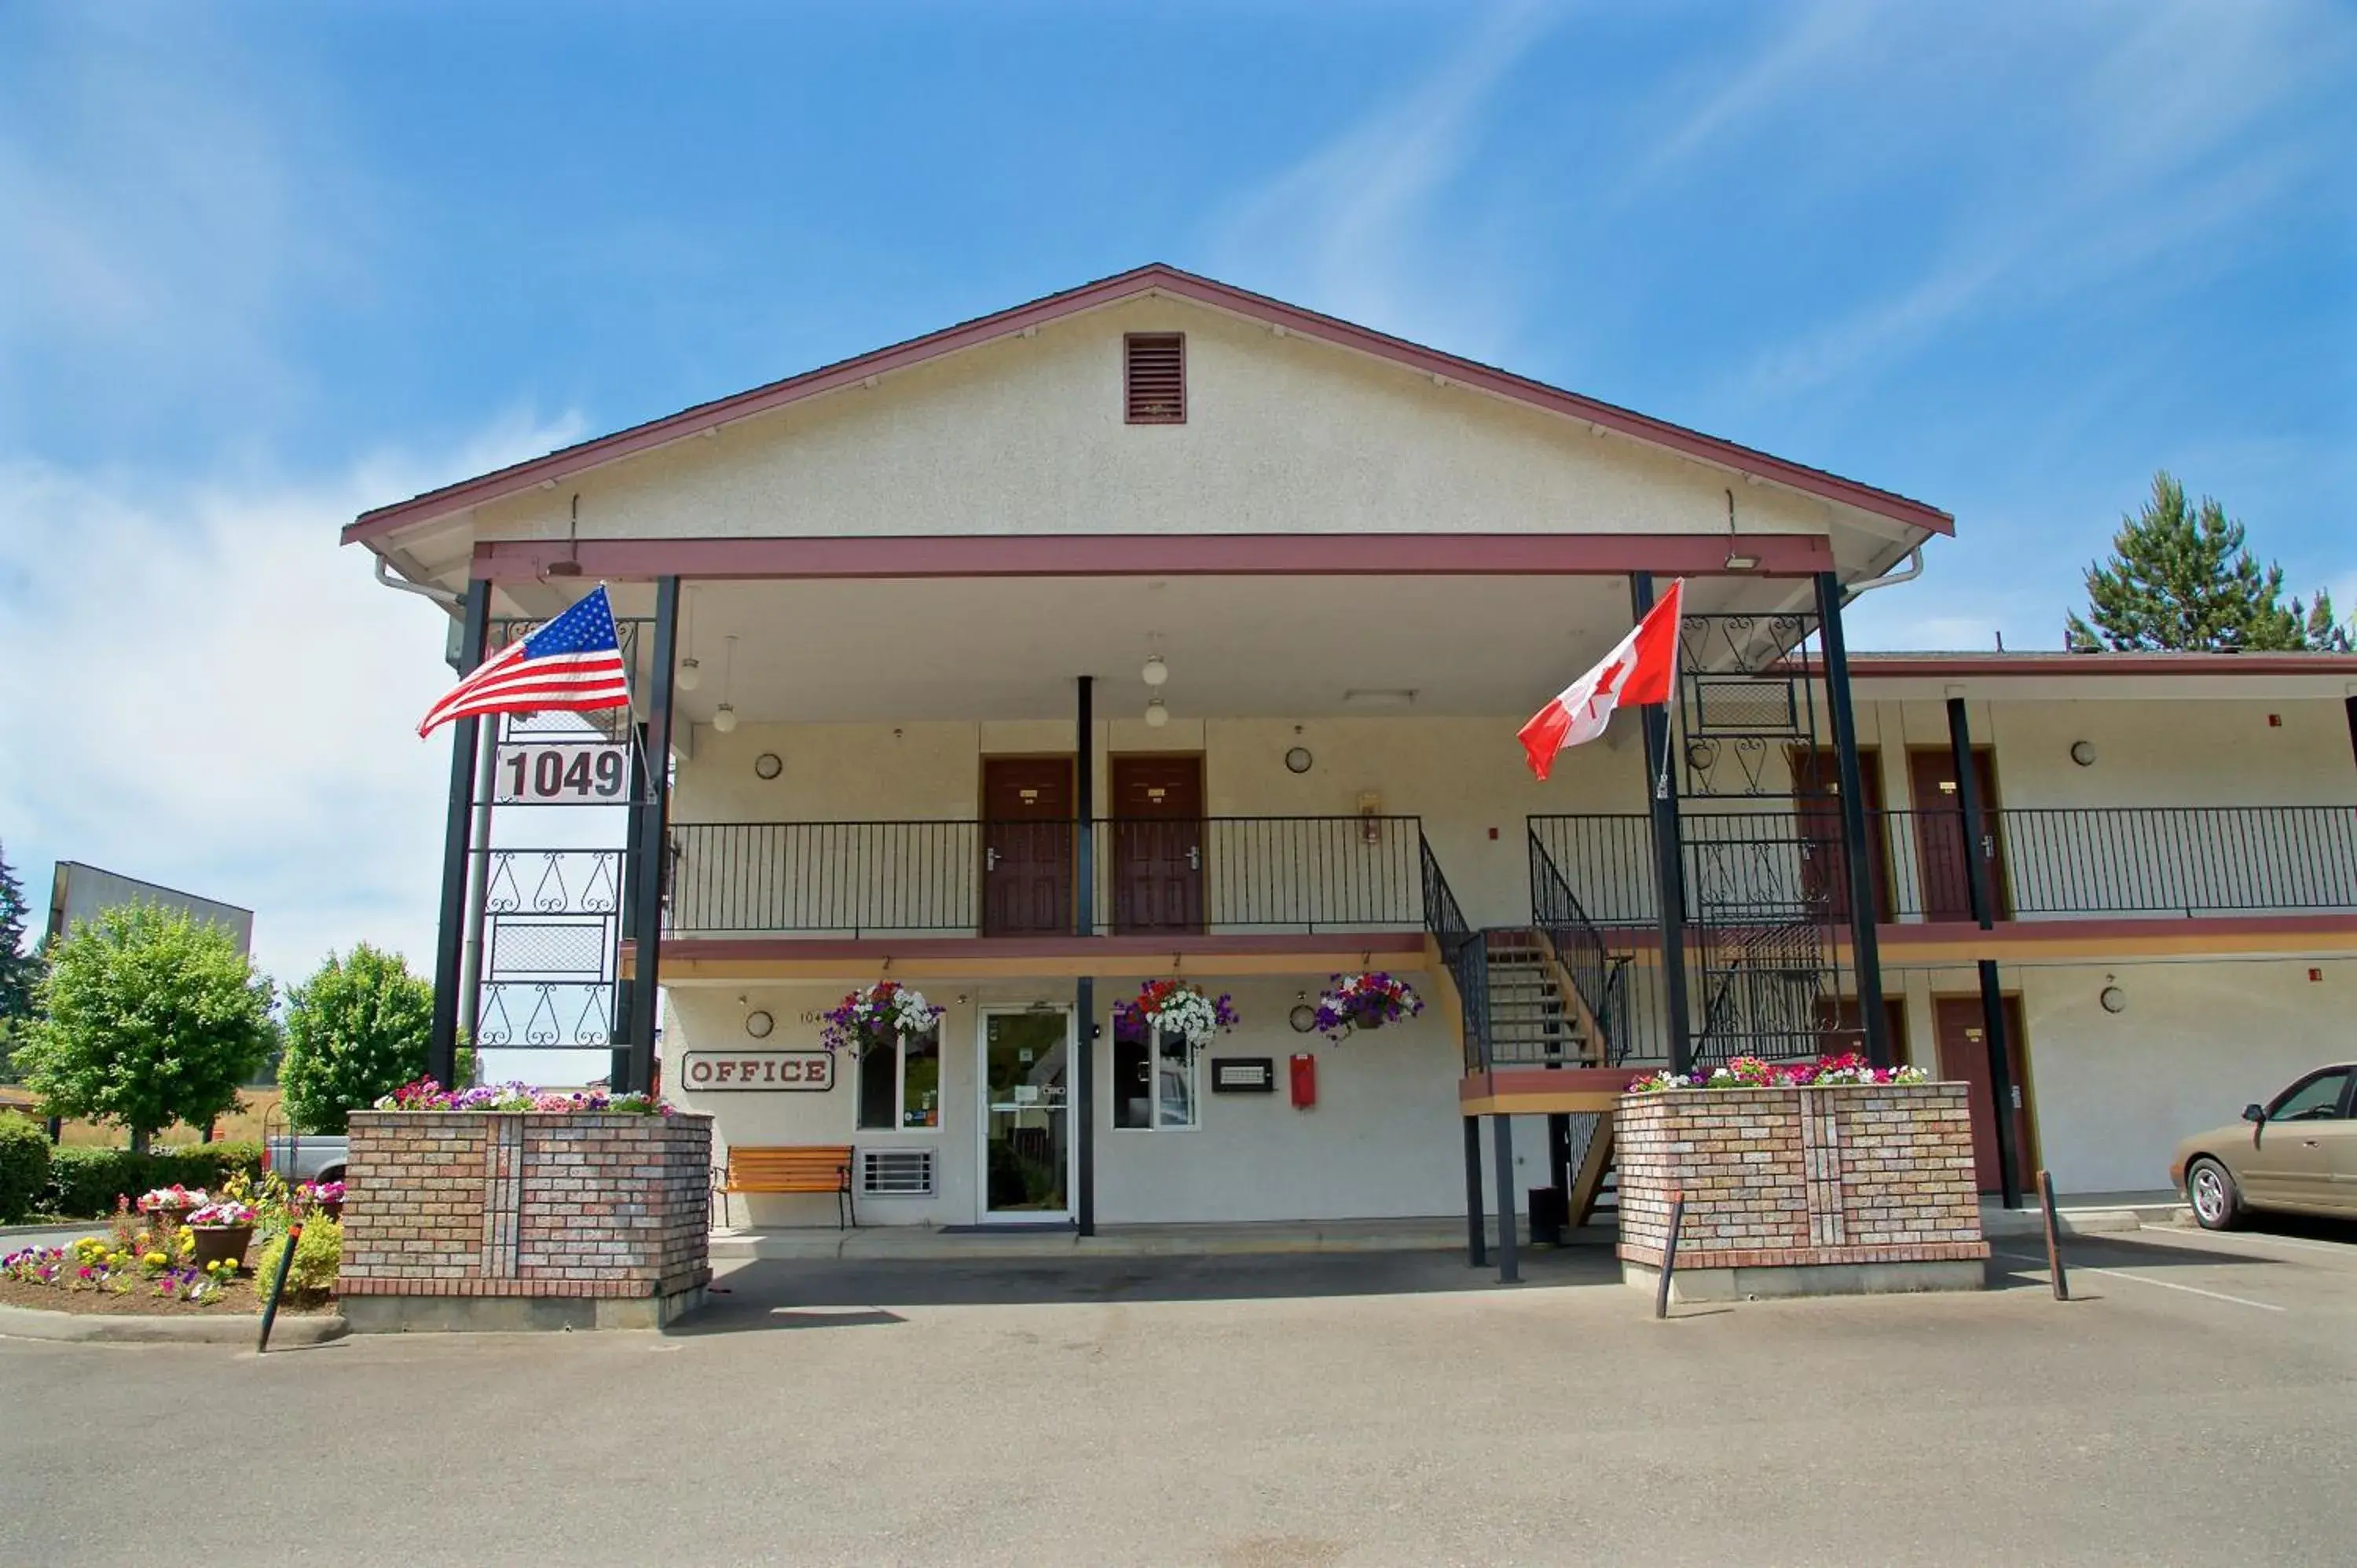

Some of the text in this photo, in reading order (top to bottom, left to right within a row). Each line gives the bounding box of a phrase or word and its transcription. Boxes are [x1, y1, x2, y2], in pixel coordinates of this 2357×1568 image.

[507, 750, 623, 797] 1049
[800, 1010, 825, 1024] 104
[691, 1061, 827, 1083] OFFICE
